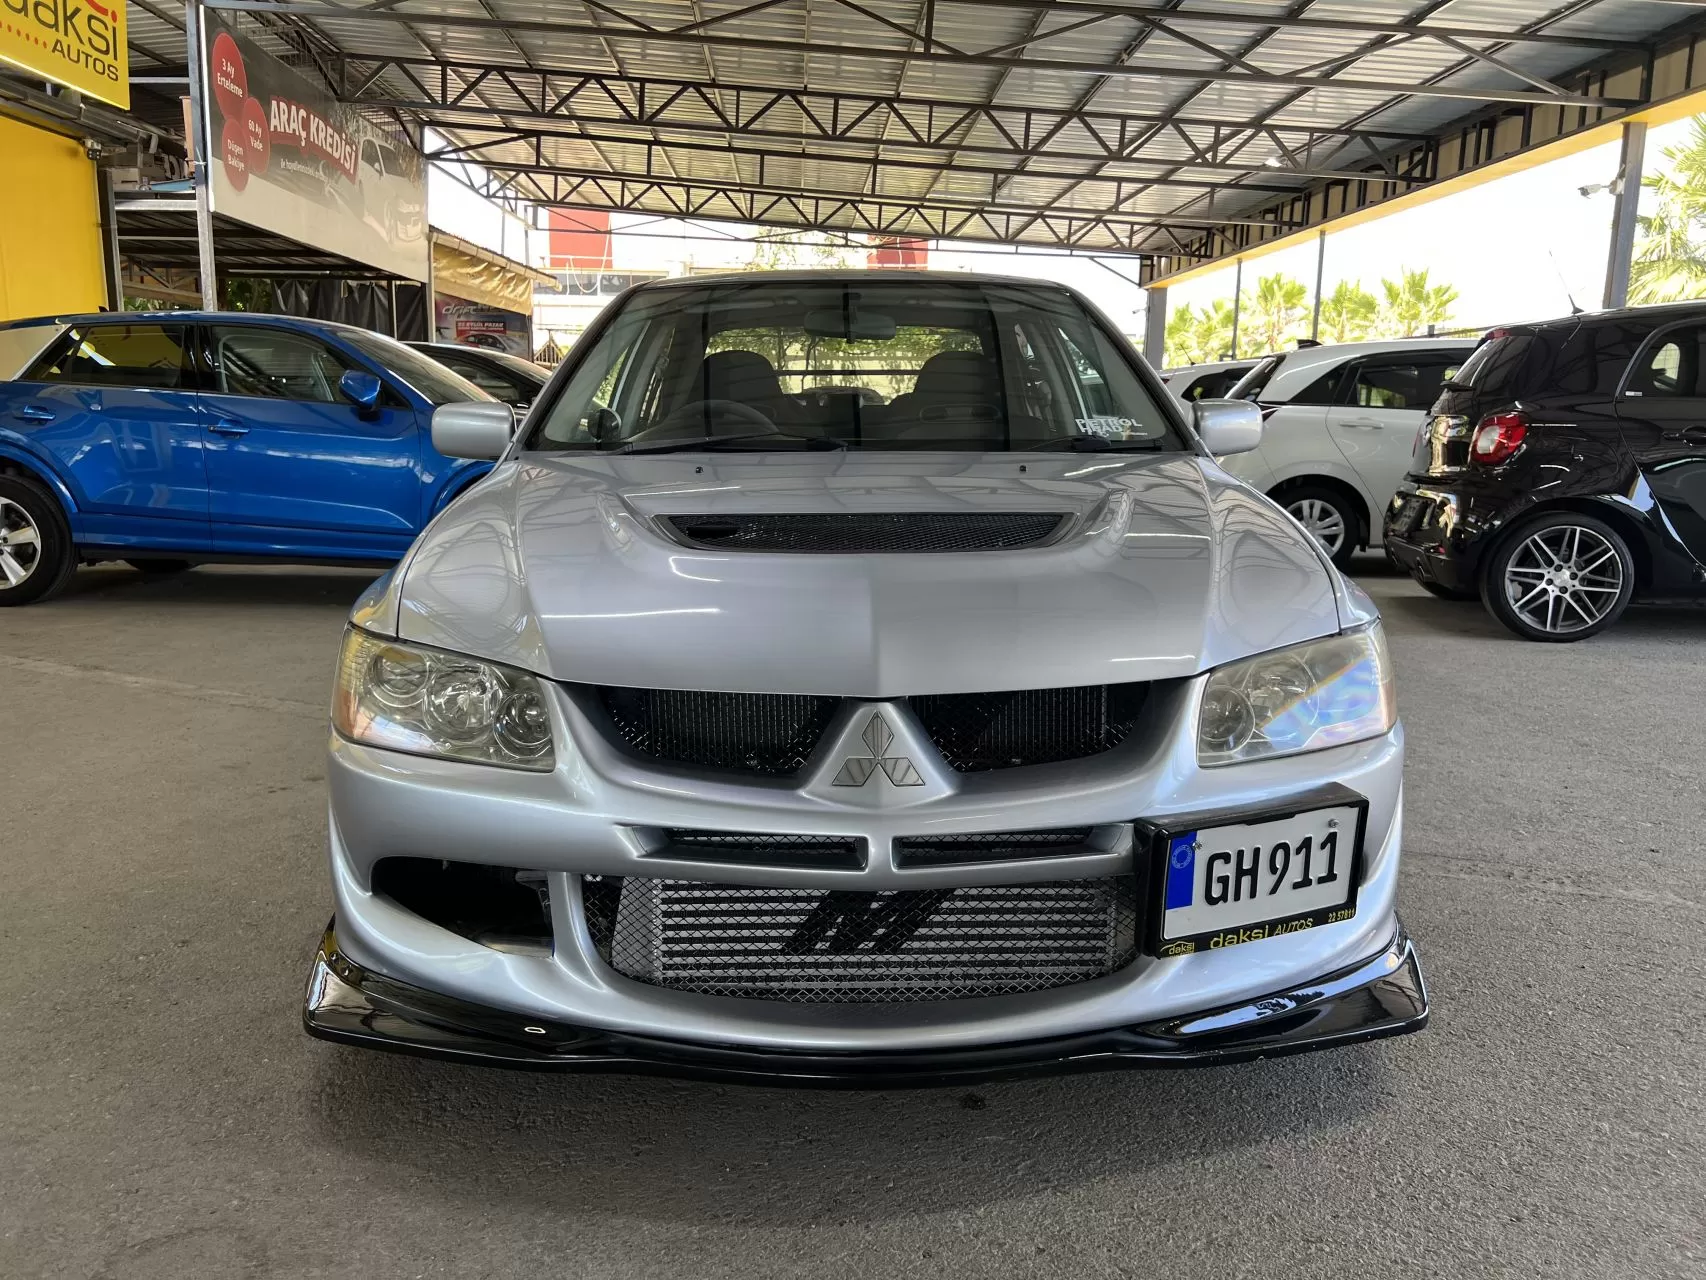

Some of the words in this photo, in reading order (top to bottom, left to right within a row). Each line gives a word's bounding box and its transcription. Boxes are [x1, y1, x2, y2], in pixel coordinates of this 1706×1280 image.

[51, 38, 119, 82] AUTOS
[222, 58, 227, 71] 3
[227, 61, 235, 79] Ay
[217, 72, 243, 98] Erteleme
[248, 119, 255, 132] 60
[270, 100, 307, 147] ARAÇ
[310, 113, 356, 175] KREDİSİ
[1075, 418, 1143, 428] PETROL
[1209, 924, 1269, 949] daksi
[1274, 918, 1313, 936] AUTOS
[1168, 941, 1195, 955] daksi
